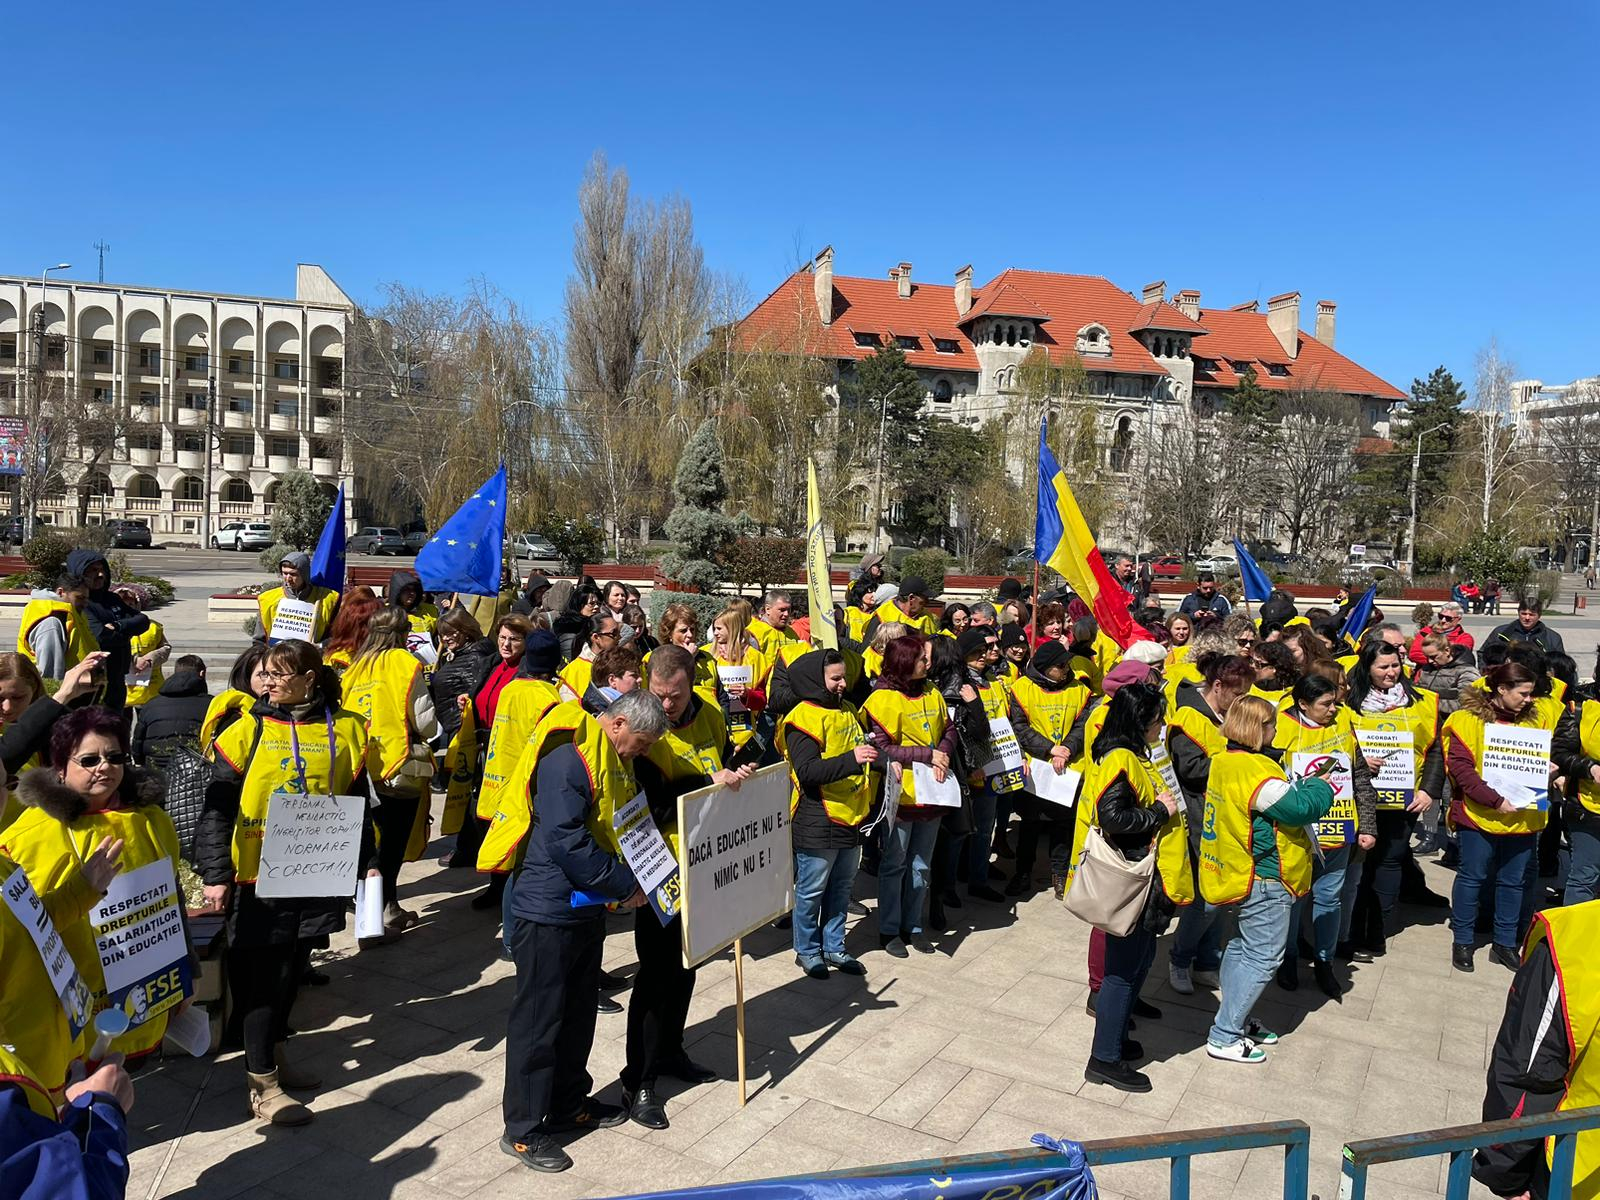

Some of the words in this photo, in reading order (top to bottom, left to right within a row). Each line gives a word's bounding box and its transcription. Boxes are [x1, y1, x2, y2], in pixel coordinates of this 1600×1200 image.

[1488, 745, 1542, 757] DREPTURILE
[1490, 737, 1543, 750] RESPECTAȚI
[1484, 753, 1547, 767] SALARIAȚILOR
[1002, 770, 1022, 785] FSE
[281, 796, 326, 810] PERSONAL
[620, 830, 636, 845] PENTRU
[1319, 822, 1345, 834] FSE
[283, 840, 351, 855] NORMARE
[631, 837, 658, 863] PERSONALULUI
[688, 836, 713, 868] DACĂ
[762, 815, 774, 836] NU
[633, 857, 651, 875] DIDACTIC
[650, 842, 666, 861] AUXILIAR
[743, 854, 756, 876] NU
[99, 883, 168, 919] RESPECTAȚI
[100, 897, 170, 935] DREPTURILE
[98, 909, 178, 952] SALARIAȚILOR
[101, 949, 125, 968] DIN
[145, 967, 182, 1004] FSE
